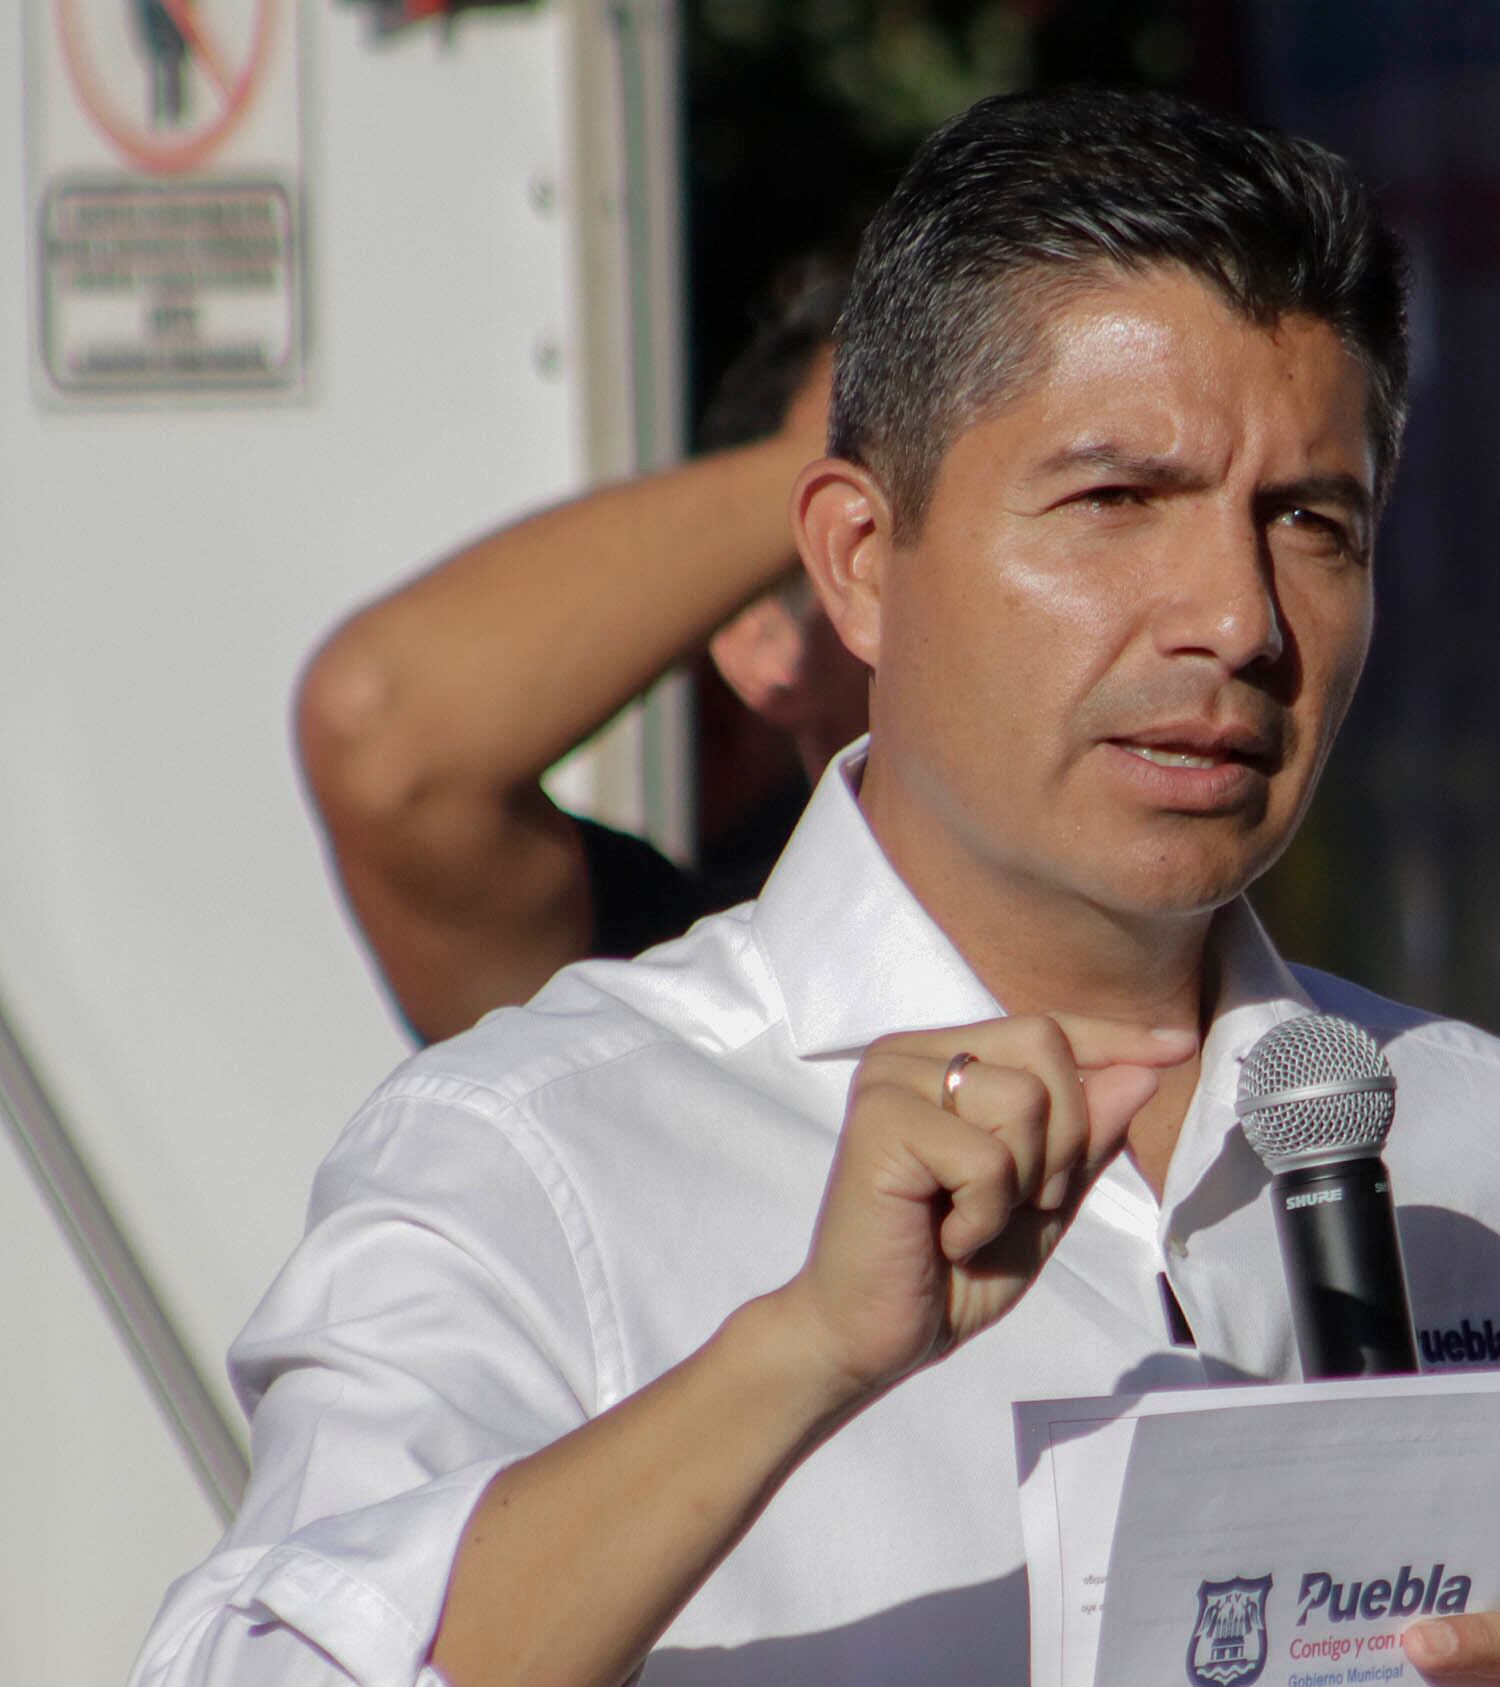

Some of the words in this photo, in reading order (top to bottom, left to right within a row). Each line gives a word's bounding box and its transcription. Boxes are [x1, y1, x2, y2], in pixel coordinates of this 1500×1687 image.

[1286, 1189, 1343, 1211] SHURE
[1296, 1563, 1472, 1627] Puebla
[1289, 1633, 1351, 1662] Contigo
[1355, 1637, 1365, 1659] y
[1367, 1632, 1396, 1651] con
[1288, 1670, 1344, 1687] Gobierno
[1347, 1663, 1404, 1684] Municipal
